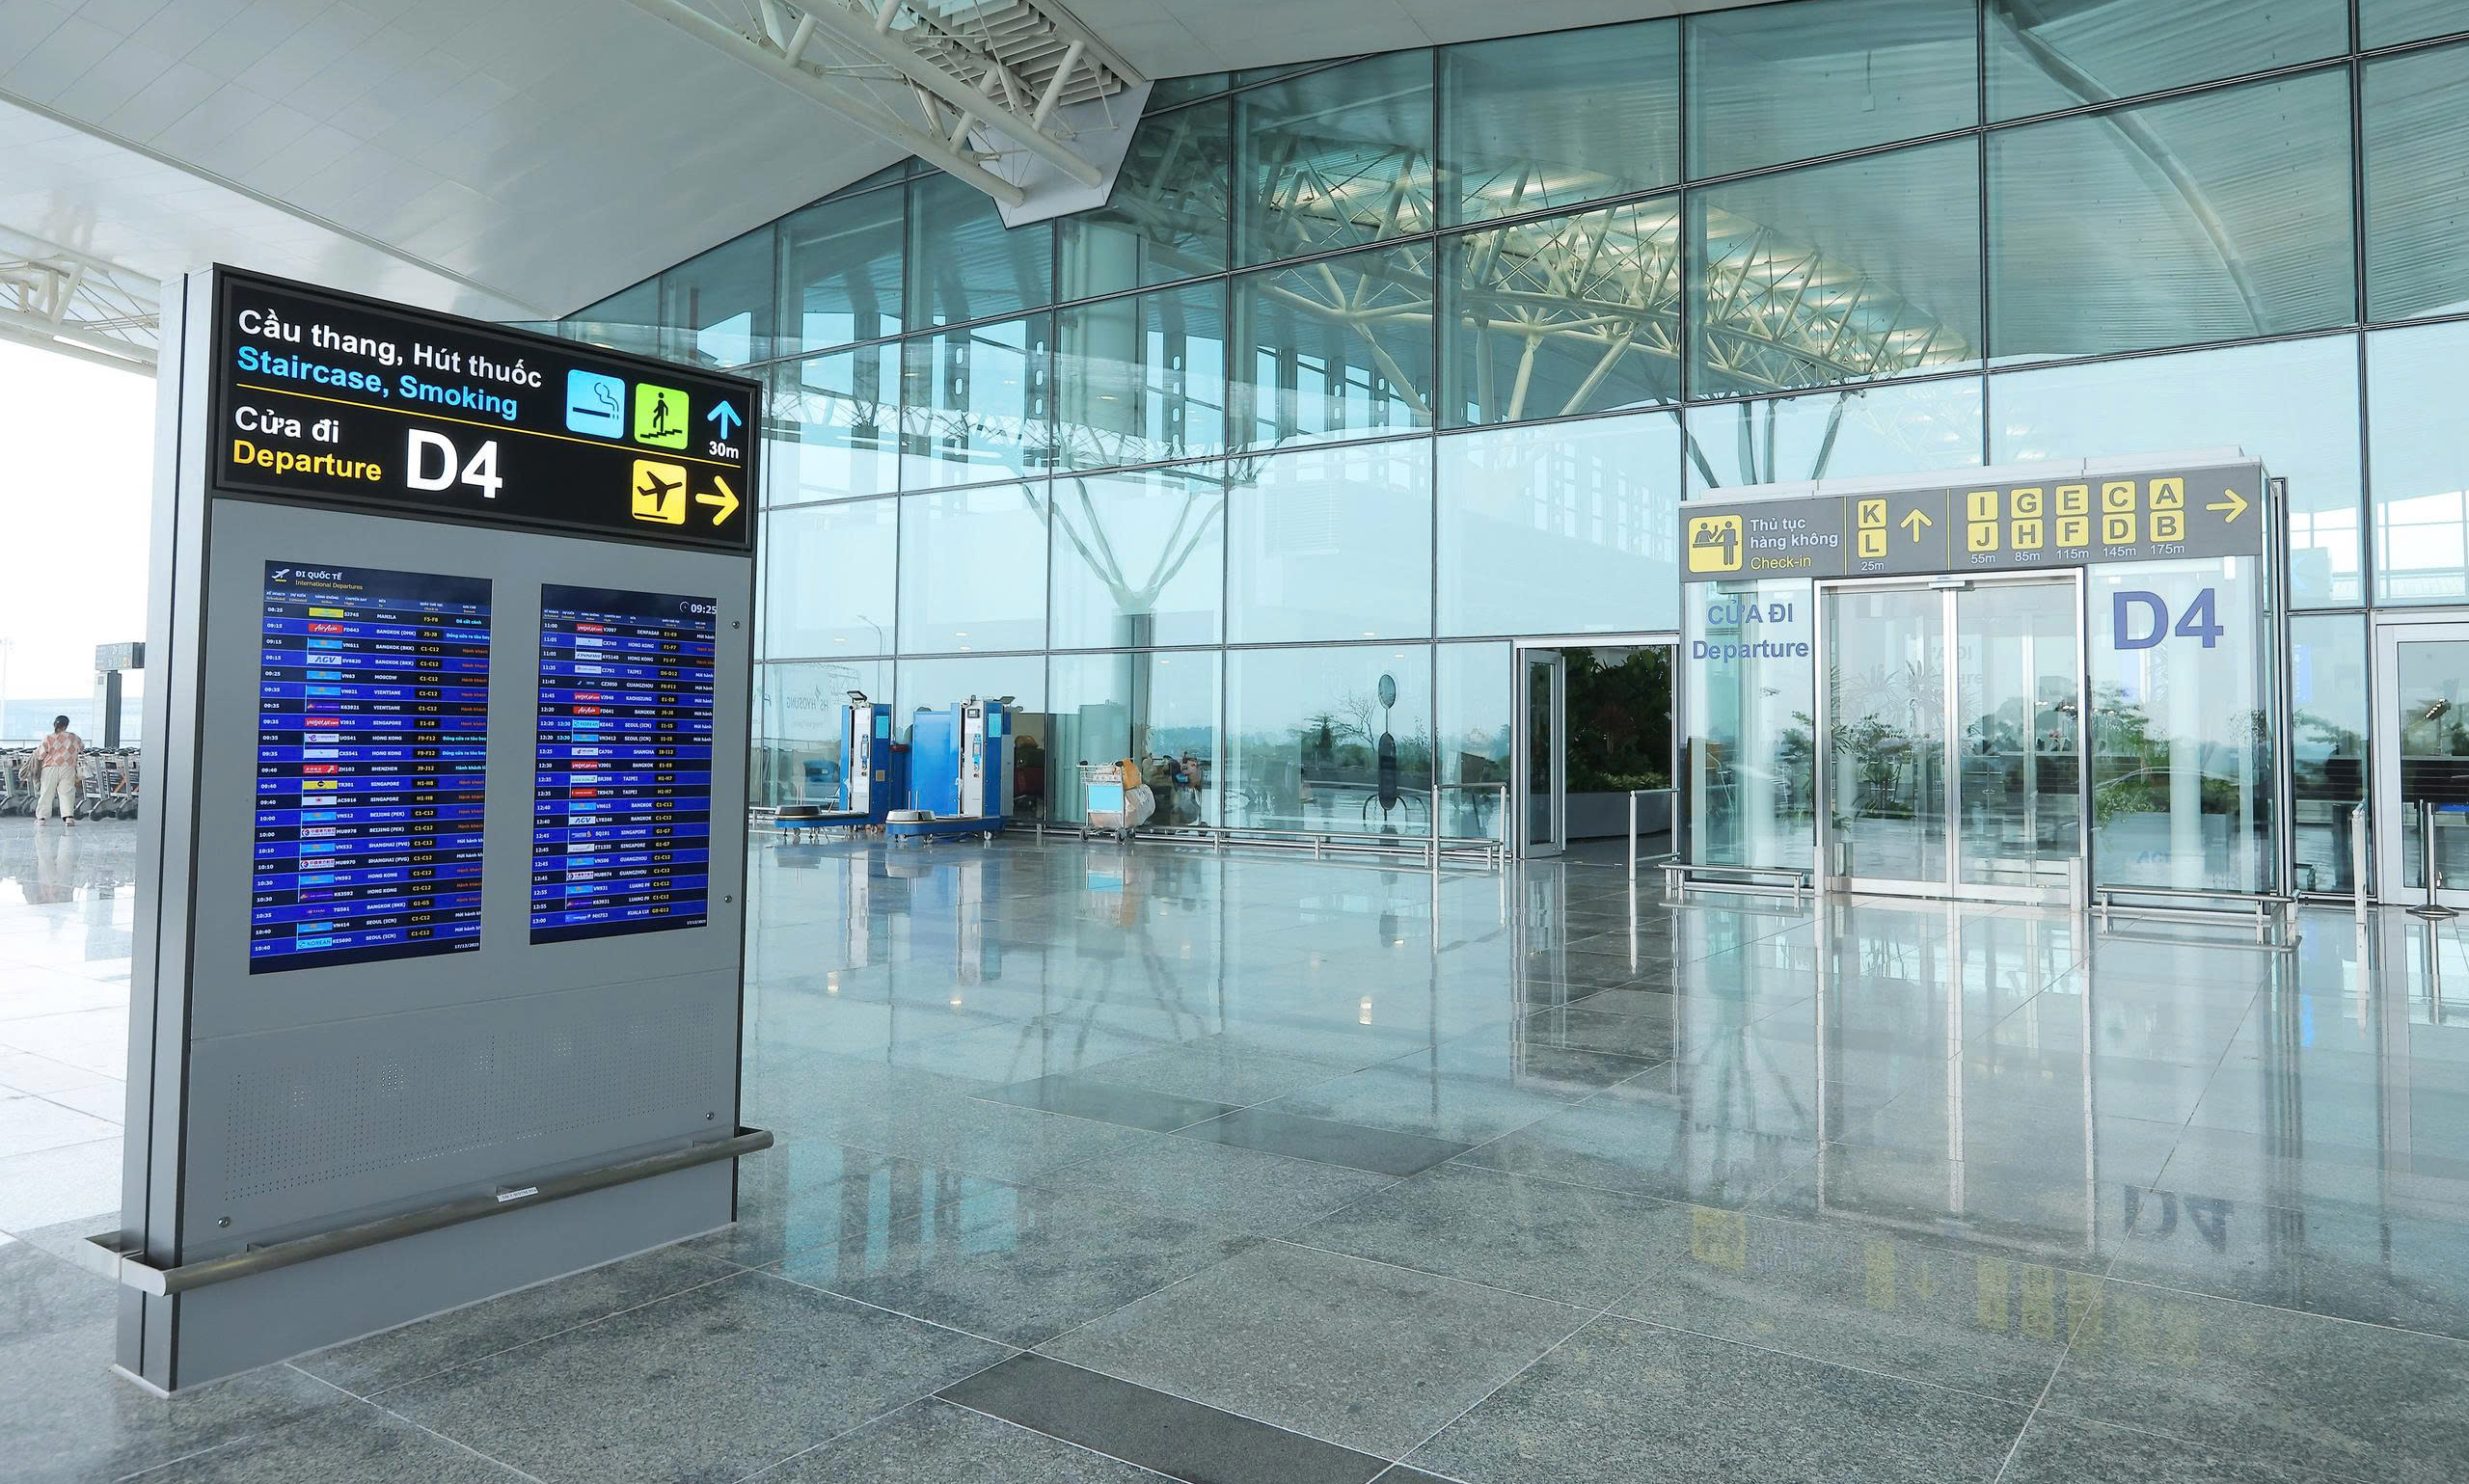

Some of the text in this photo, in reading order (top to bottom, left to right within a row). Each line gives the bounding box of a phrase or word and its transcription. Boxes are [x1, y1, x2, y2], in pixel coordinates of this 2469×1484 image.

[238, 309, 542, 388] Cầu thang, Hút thuốc
[238, 346, 518, 420] Staircase, Smoking
[234, 405, 340, 443] Cửa đi
[233, 439, 382, 482] Departure
[709, 441, 740, 460] 30m
[406, 428, 504, 499] D4
[1980, 483, 2177, 516] I G E C A
[1750, 516, 1806, 534] Thủ tục
[1863, 505, 1881, 523] K
[1750, 530, 1839, 552] hàng không
[1976, 516, 2177, 547] J H F D B
[1865, 534, 1880, 553] L
[1970, 543, 2185, 564] 55m 85m 115m 145m 175m
[1751, 554, 1812, 570] Check-in
[1861, 560, 1885, 572] 25m
[295, 580, 332, 588] International
[307, 570, 331, 580] QUỐC
[332, 571, 343, 580] TẾ
[691, 604, 717, 614] 09:25
[1708, 598, 1794, 625] CỬA ĐI
[2113, 588, 2224, 651] D4
[1692, 639, 1810, 662] Departure
